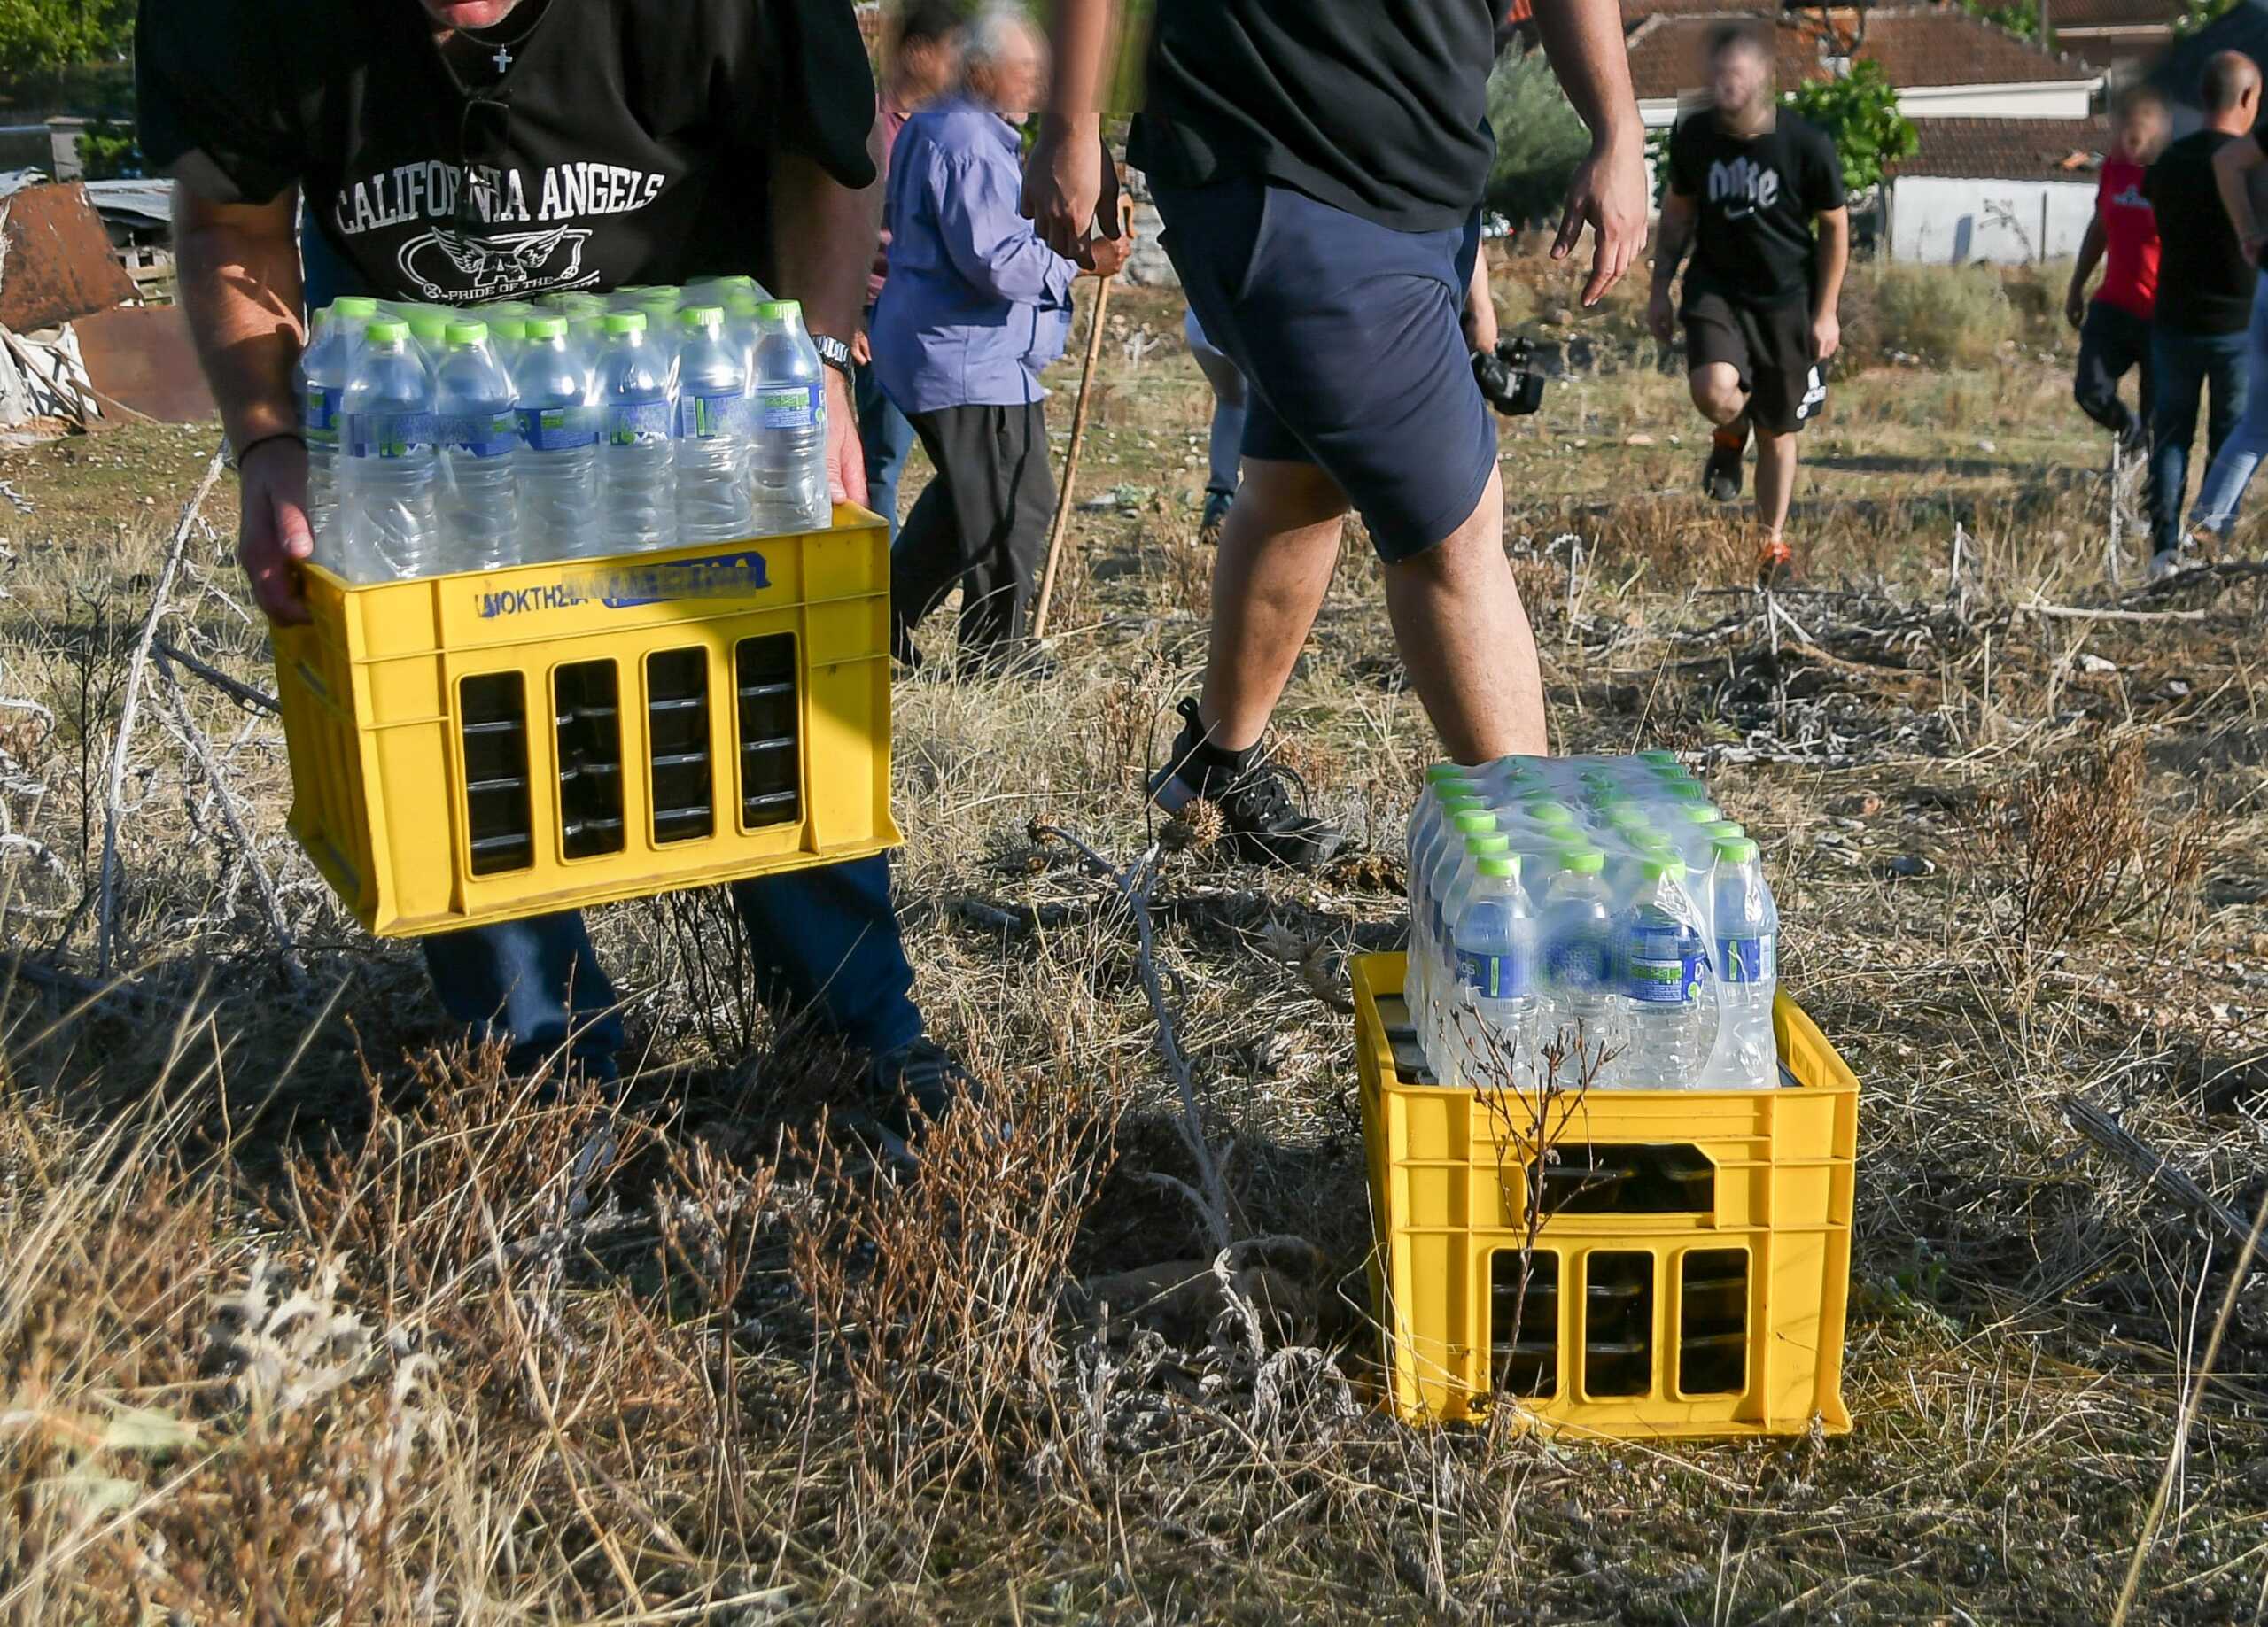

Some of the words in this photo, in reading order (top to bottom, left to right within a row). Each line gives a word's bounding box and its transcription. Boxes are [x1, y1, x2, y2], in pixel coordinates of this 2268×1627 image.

[537, 161, 666, 221] ANGELS
[448, 286, 495, 299] PRIDE
[499, 283, 519, 292] OF
[523, 276, 554, 288] THE
